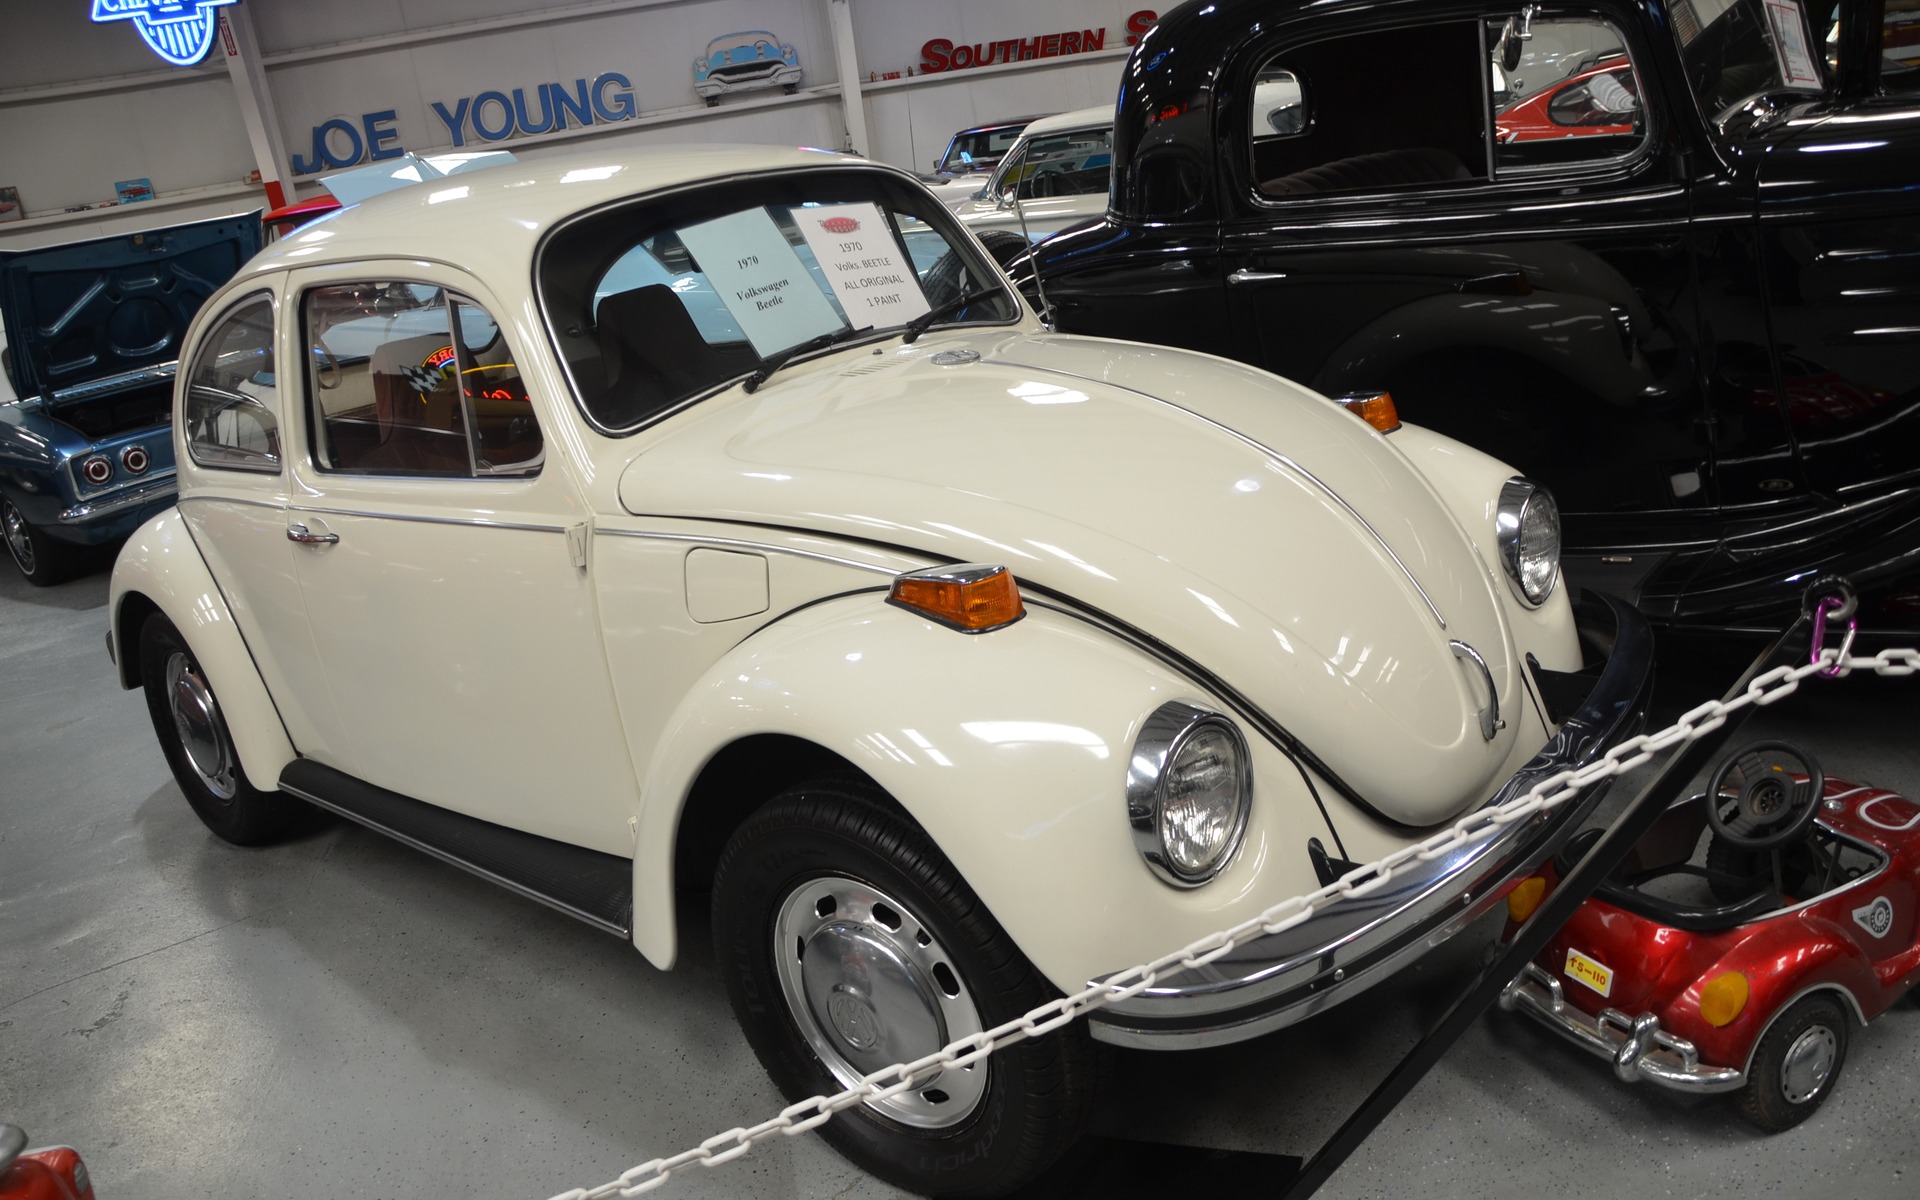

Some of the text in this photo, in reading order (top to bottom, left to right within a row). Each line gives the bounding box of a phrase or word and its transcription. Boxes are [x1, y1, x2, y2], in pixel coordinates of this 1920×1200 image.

[919, 28, 1105, 74] SOUTHERN
[293, 72, 636, 174] JOE YOUNG
[838, 242, 863, 253] 1970
[738, 255, 759, 270] 1970
[835, 257, 891, 272] Volks. BEETLE
[736, 279, 789, 301] Volkswagen
[844, 274, 905, 290] ALL ORIGINAL
[756, 295, 784, 311] Beetle
[866, 294, 902, 307] 1 PAINT
[1570, 958, 1606, 985] TS-110
